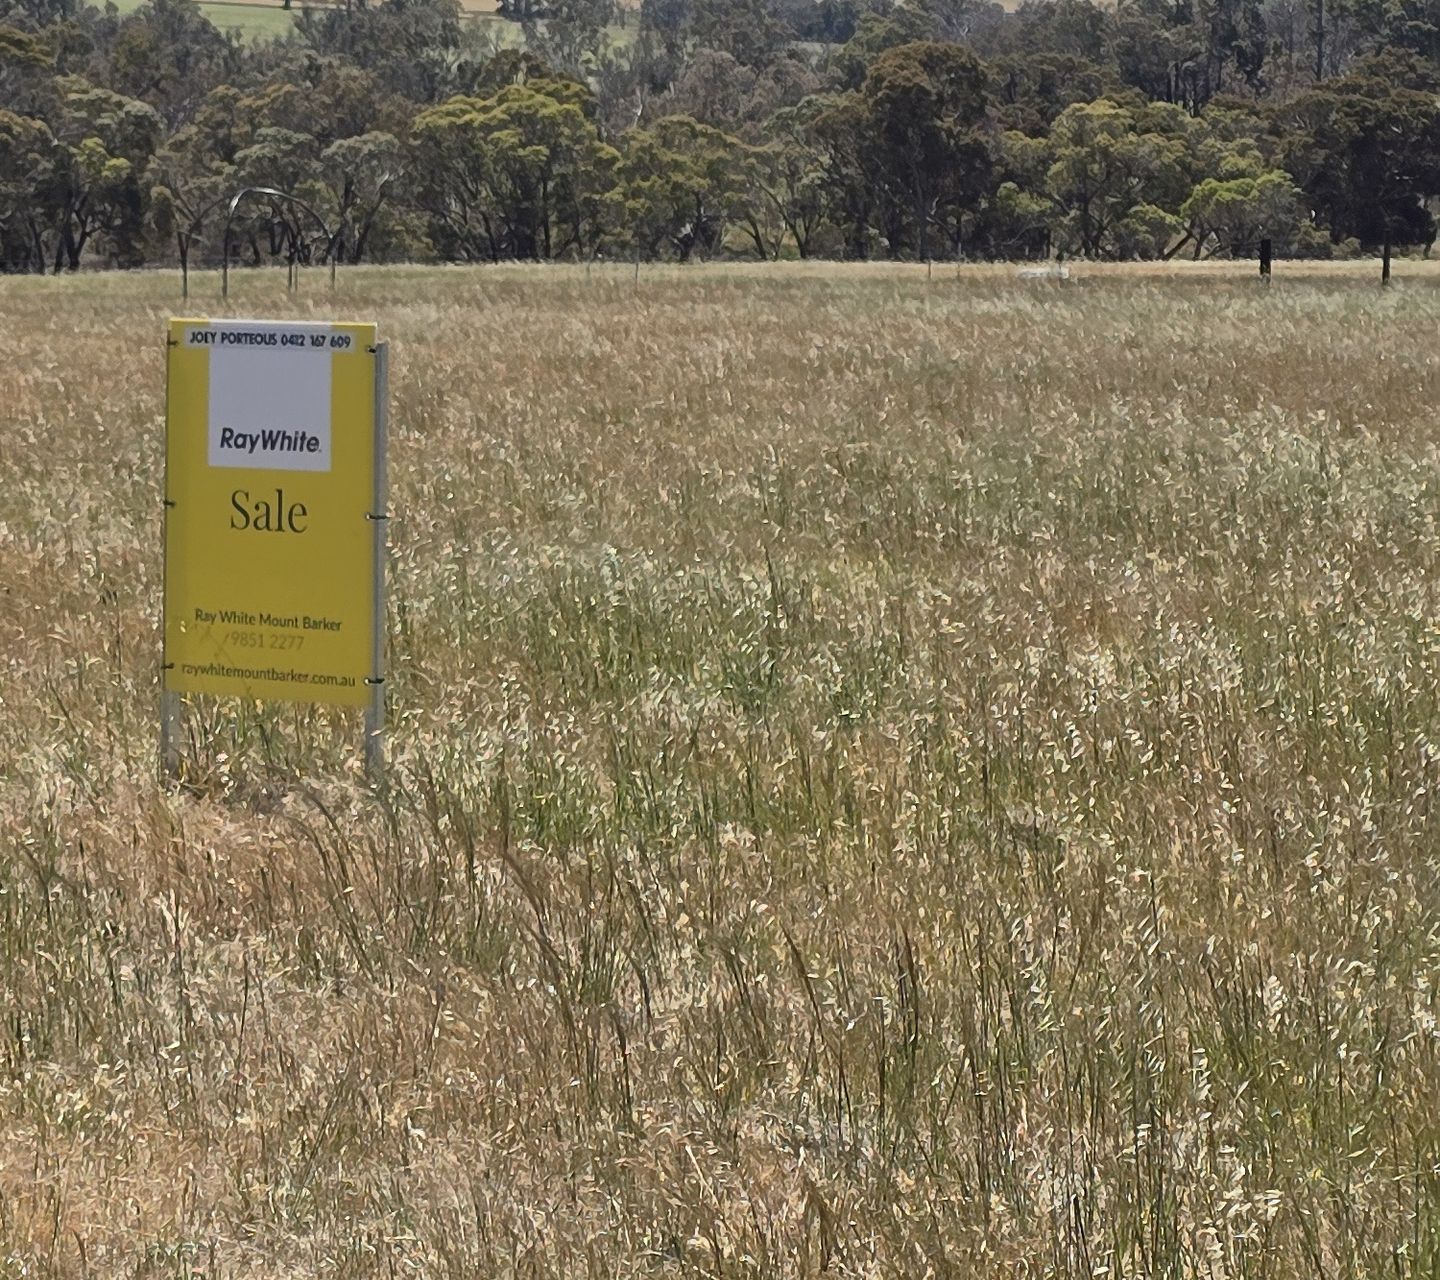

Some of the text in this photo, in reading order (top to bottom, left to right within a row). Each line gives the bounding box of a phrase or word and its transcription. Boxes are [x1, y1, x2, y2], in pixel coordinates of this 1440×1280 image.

[190, 331, 216, 344] JOEY
[221, 331, 277, 346] PORTEOUS
[330, 335, 351, 348] 609
[230, 488, 308, 533] Sale
[195, 608, 342, 631] Ray White Mount Barker
[231, 631, 304, 651] 9851 2277
[181, 663, 356, 687] raywhitemountbarker.com.au
